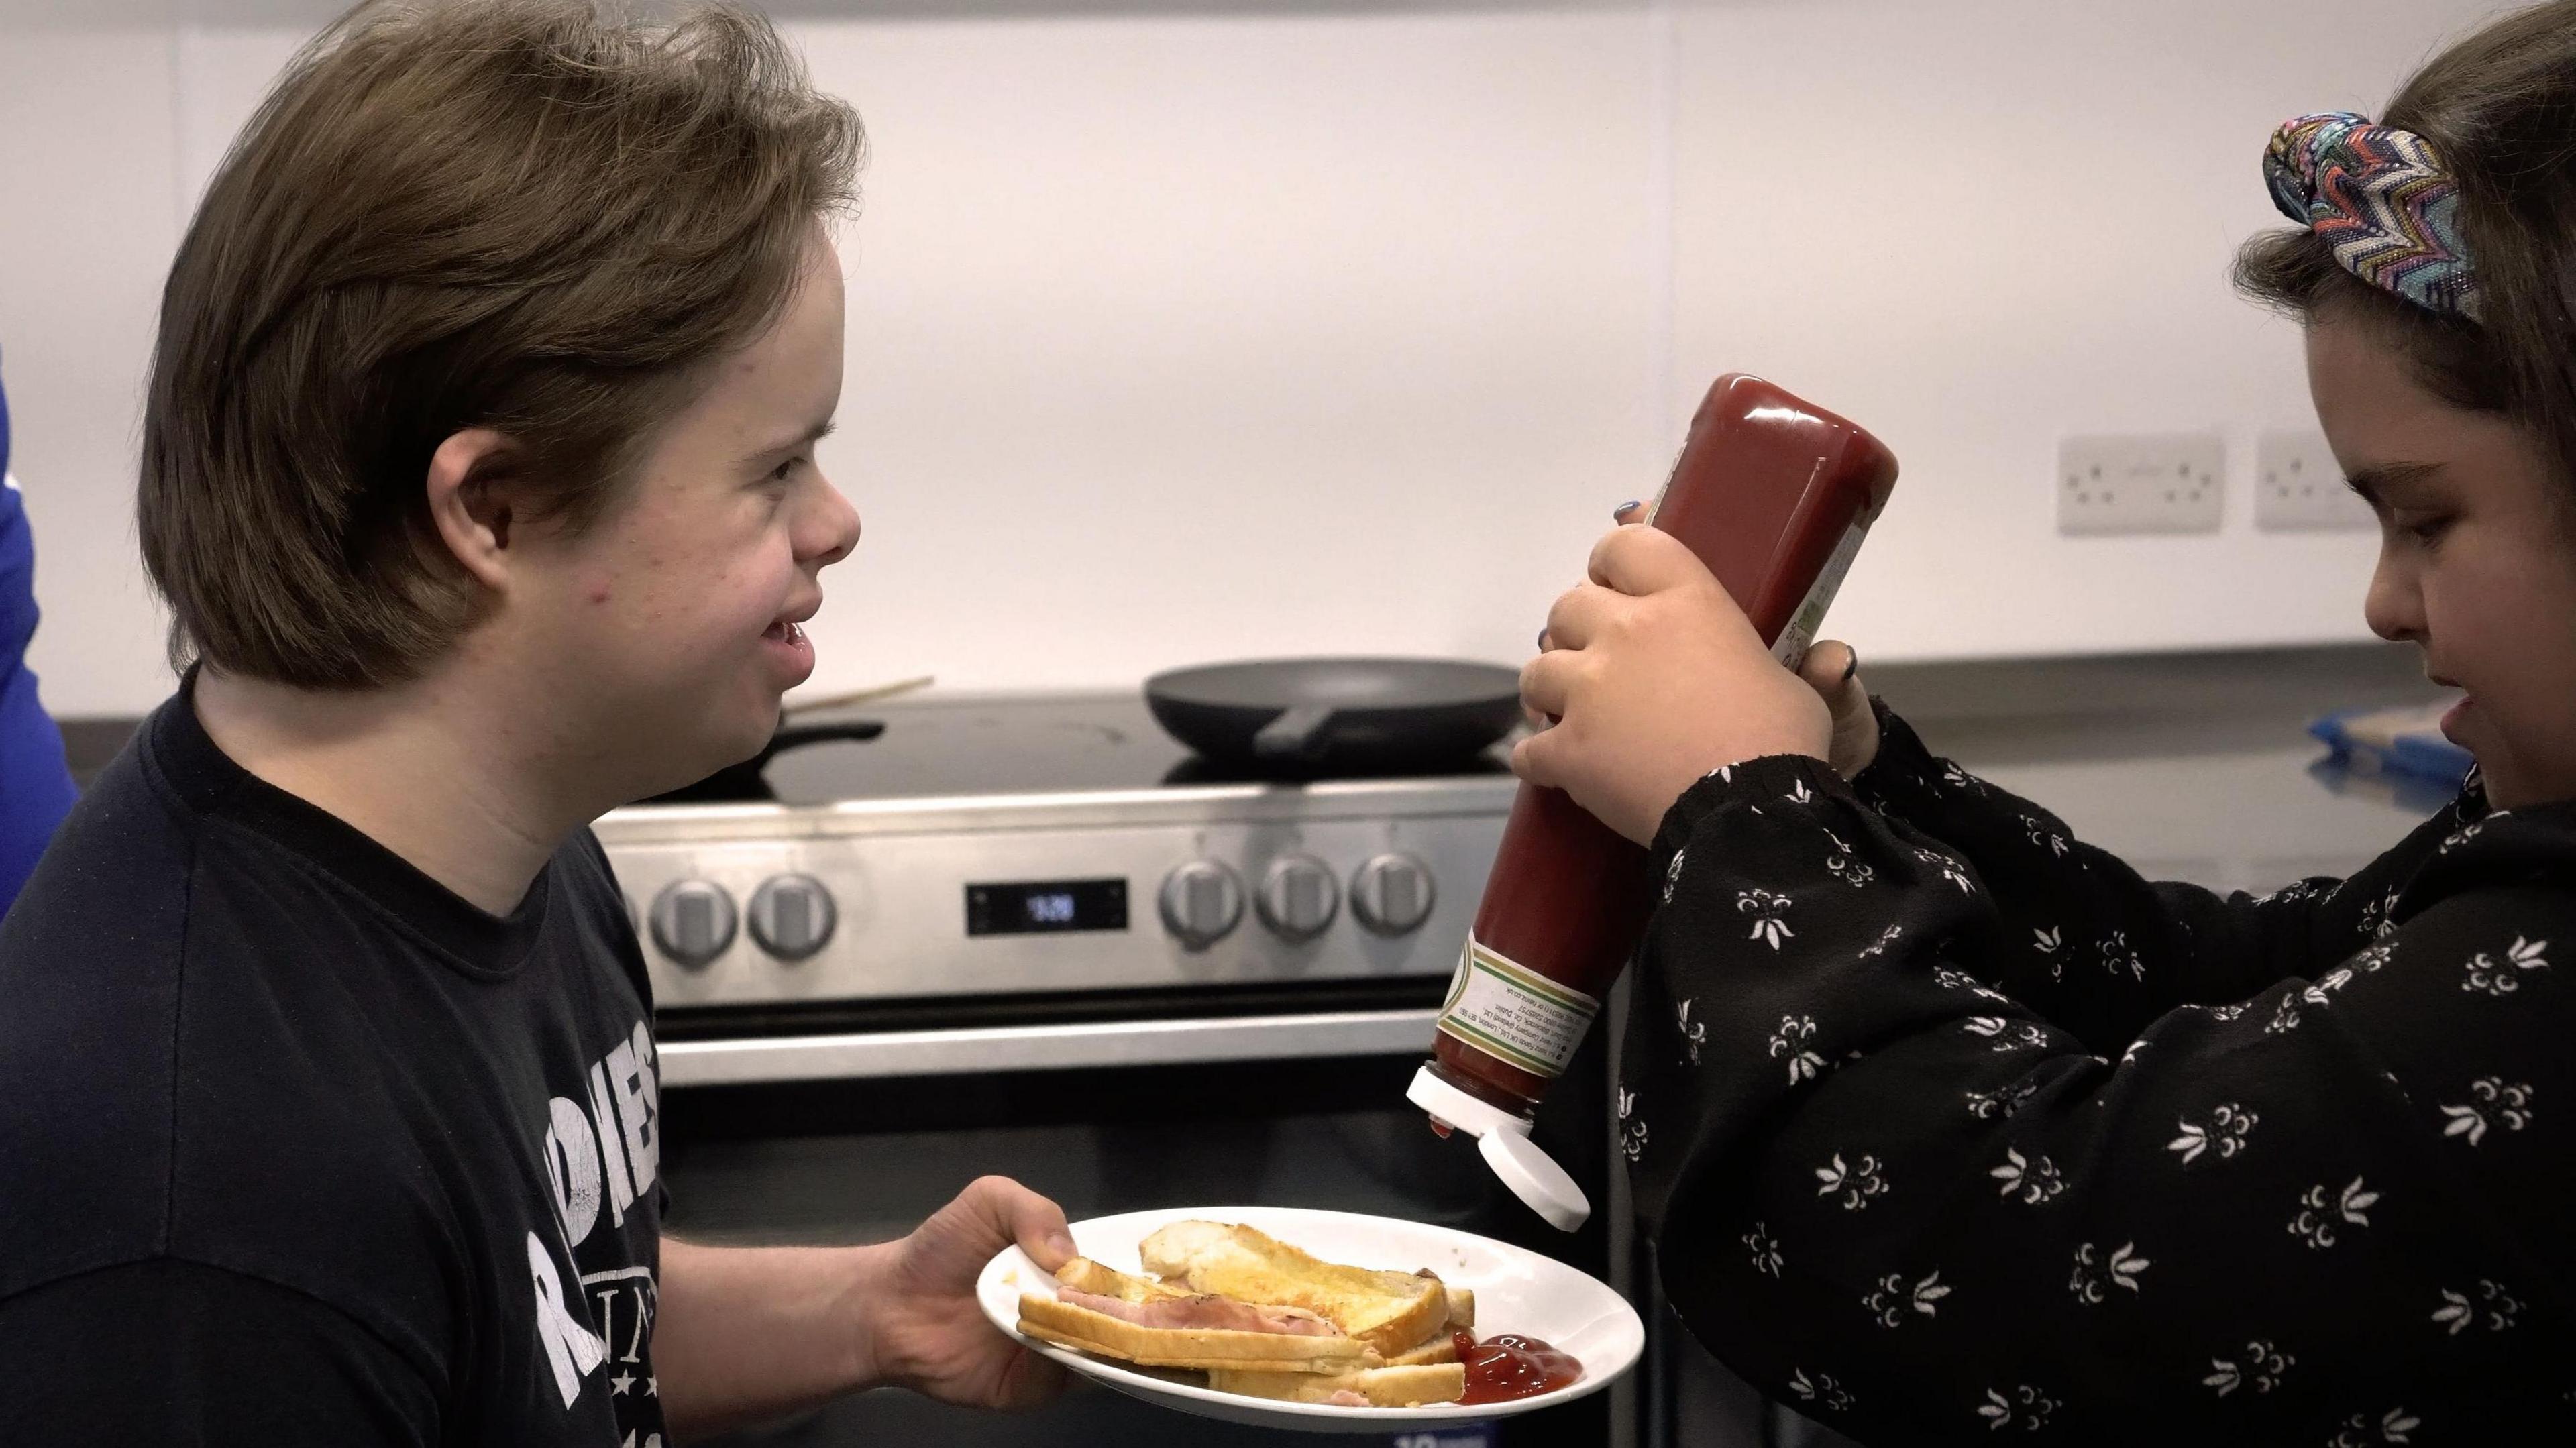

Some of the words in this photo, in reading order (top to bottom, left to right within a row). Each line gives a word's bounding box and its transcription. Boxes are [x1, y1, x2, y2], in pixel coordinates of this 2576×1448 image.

[1505, 988, 1536, 1005] heinz.co.uk
[1493, 1015, 1513, 1028] (Ireland)
[1542, 1017, 1556, 1027] 0800
[1514, 1025, 1539, 1040] Company
[1518, 1038, 1534, 1050] Foods
